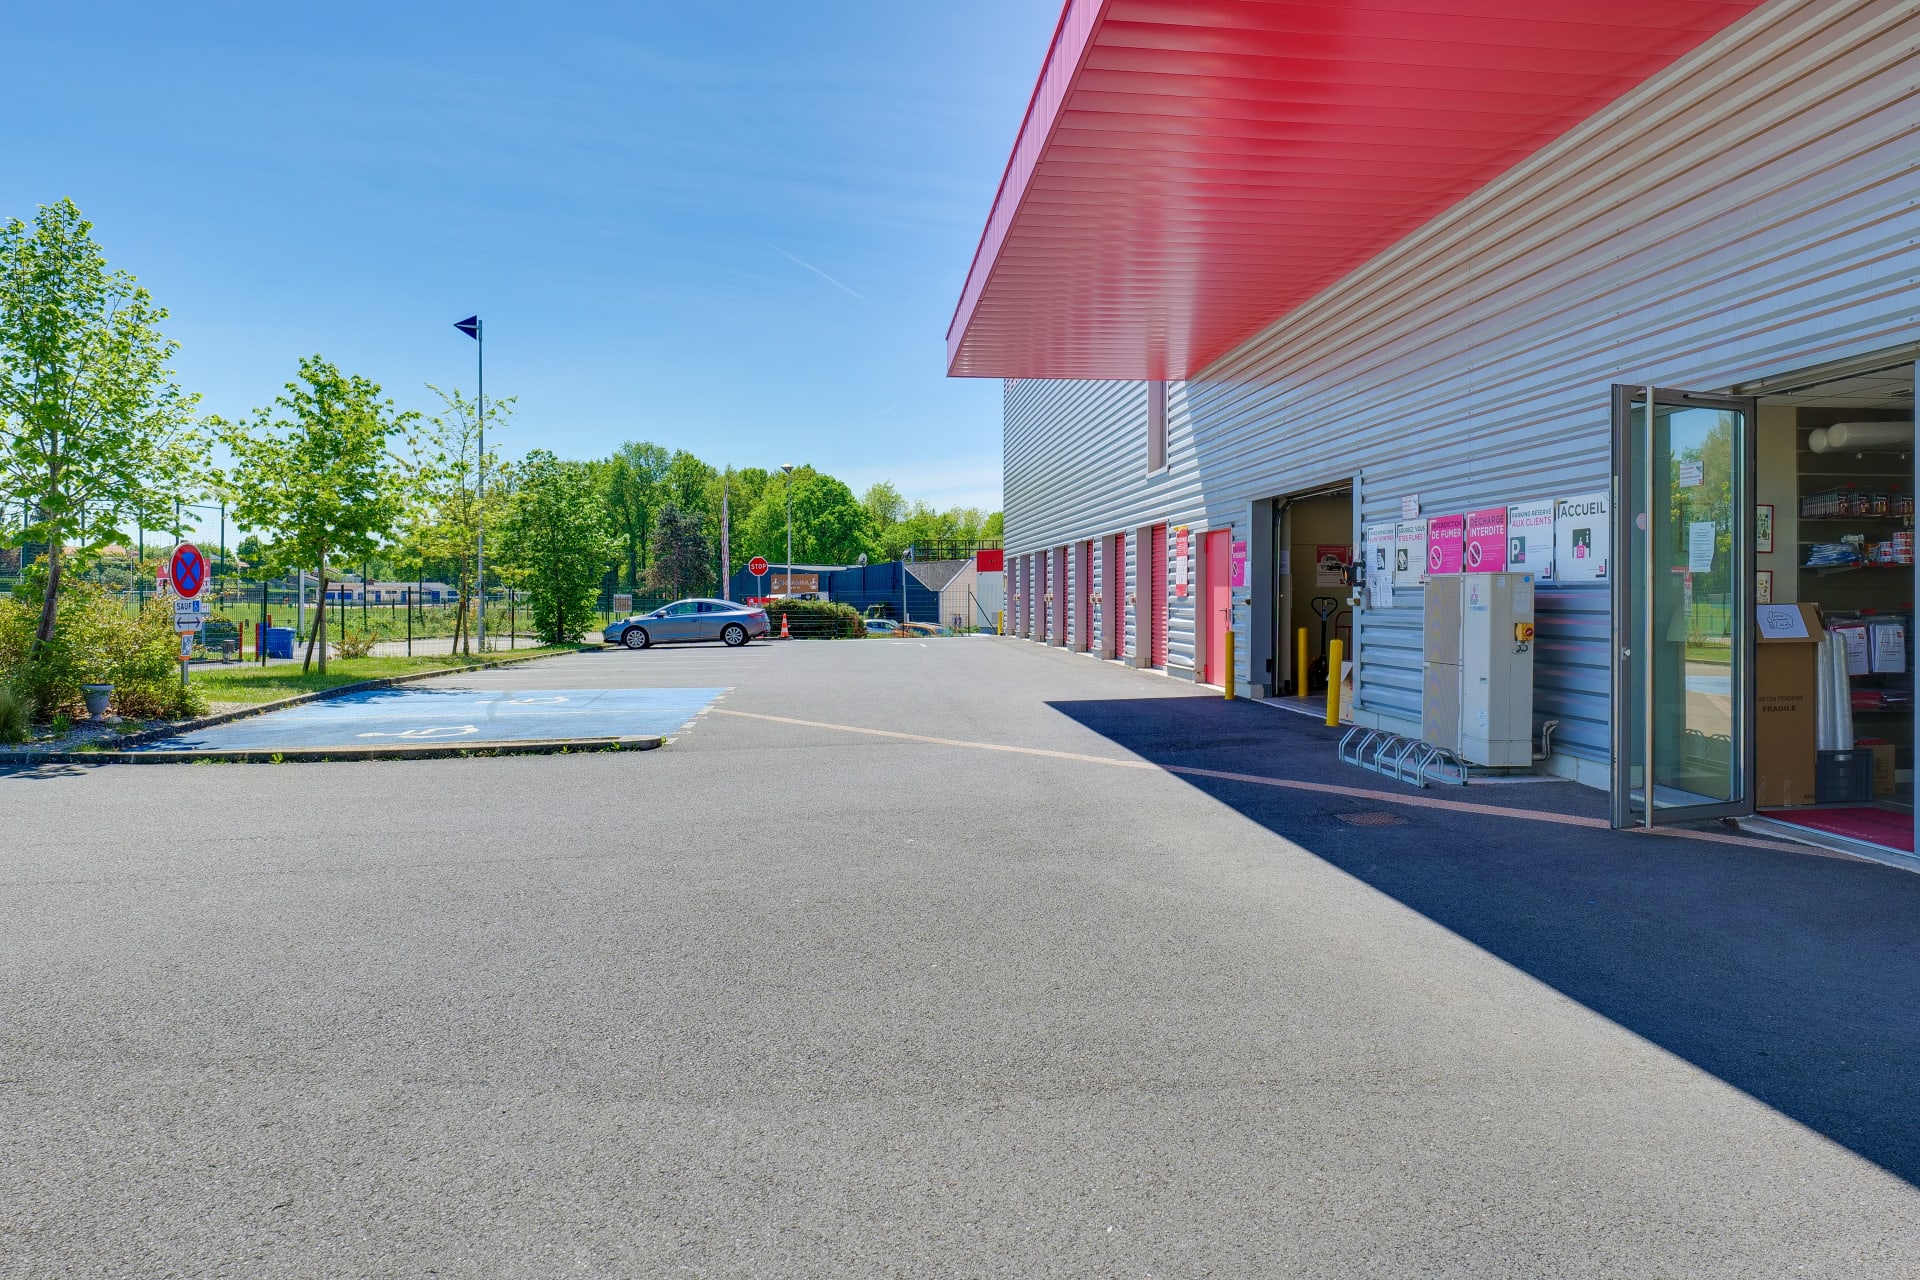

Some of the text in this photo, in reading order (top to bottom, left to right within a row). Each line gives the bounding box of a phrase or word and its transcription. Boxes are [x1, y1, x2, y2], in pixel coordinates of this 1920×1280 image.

[1561, 501, 1606, 518] ACCUEIL
[1512, 516, 1552, 528] AUX CLIENTS
[1431, 528, 1462, 540] DE FUMER
[1470, 524, 1504, 538] INTERDITE
[176, 602, 192, 611] SAUF
[1762, 704, 1797, 713] FRAGILE
